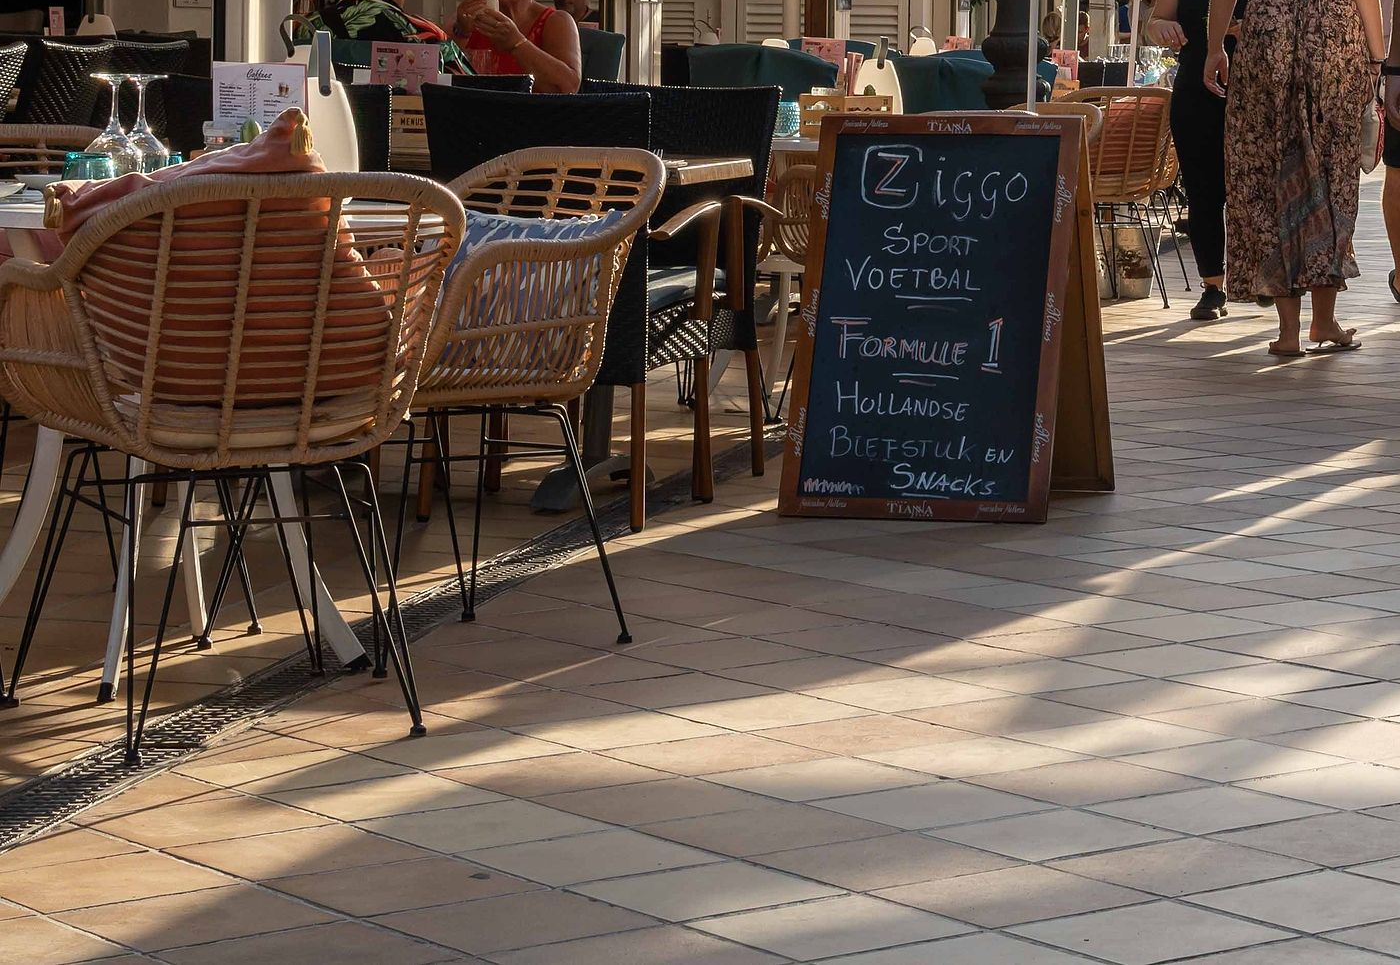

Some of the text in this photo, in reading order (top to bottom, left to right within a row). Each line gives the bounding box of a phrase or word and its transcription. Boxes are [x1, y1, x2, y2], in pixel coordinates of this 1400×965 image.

[400, 117, 424, 126] MENUS
[862, 144, 1028, 222] Ziggo
[881, 222, 979, 256] SPORT
[845, 255, 981, 292] VOETBAL
[830, 316, 1004, 375] FORMULE 1
[836, 380, 970, 422] HOLLANDSE
[984, 447, 1015, 464] EN
[889, 462, 997, 497] SNACKS
